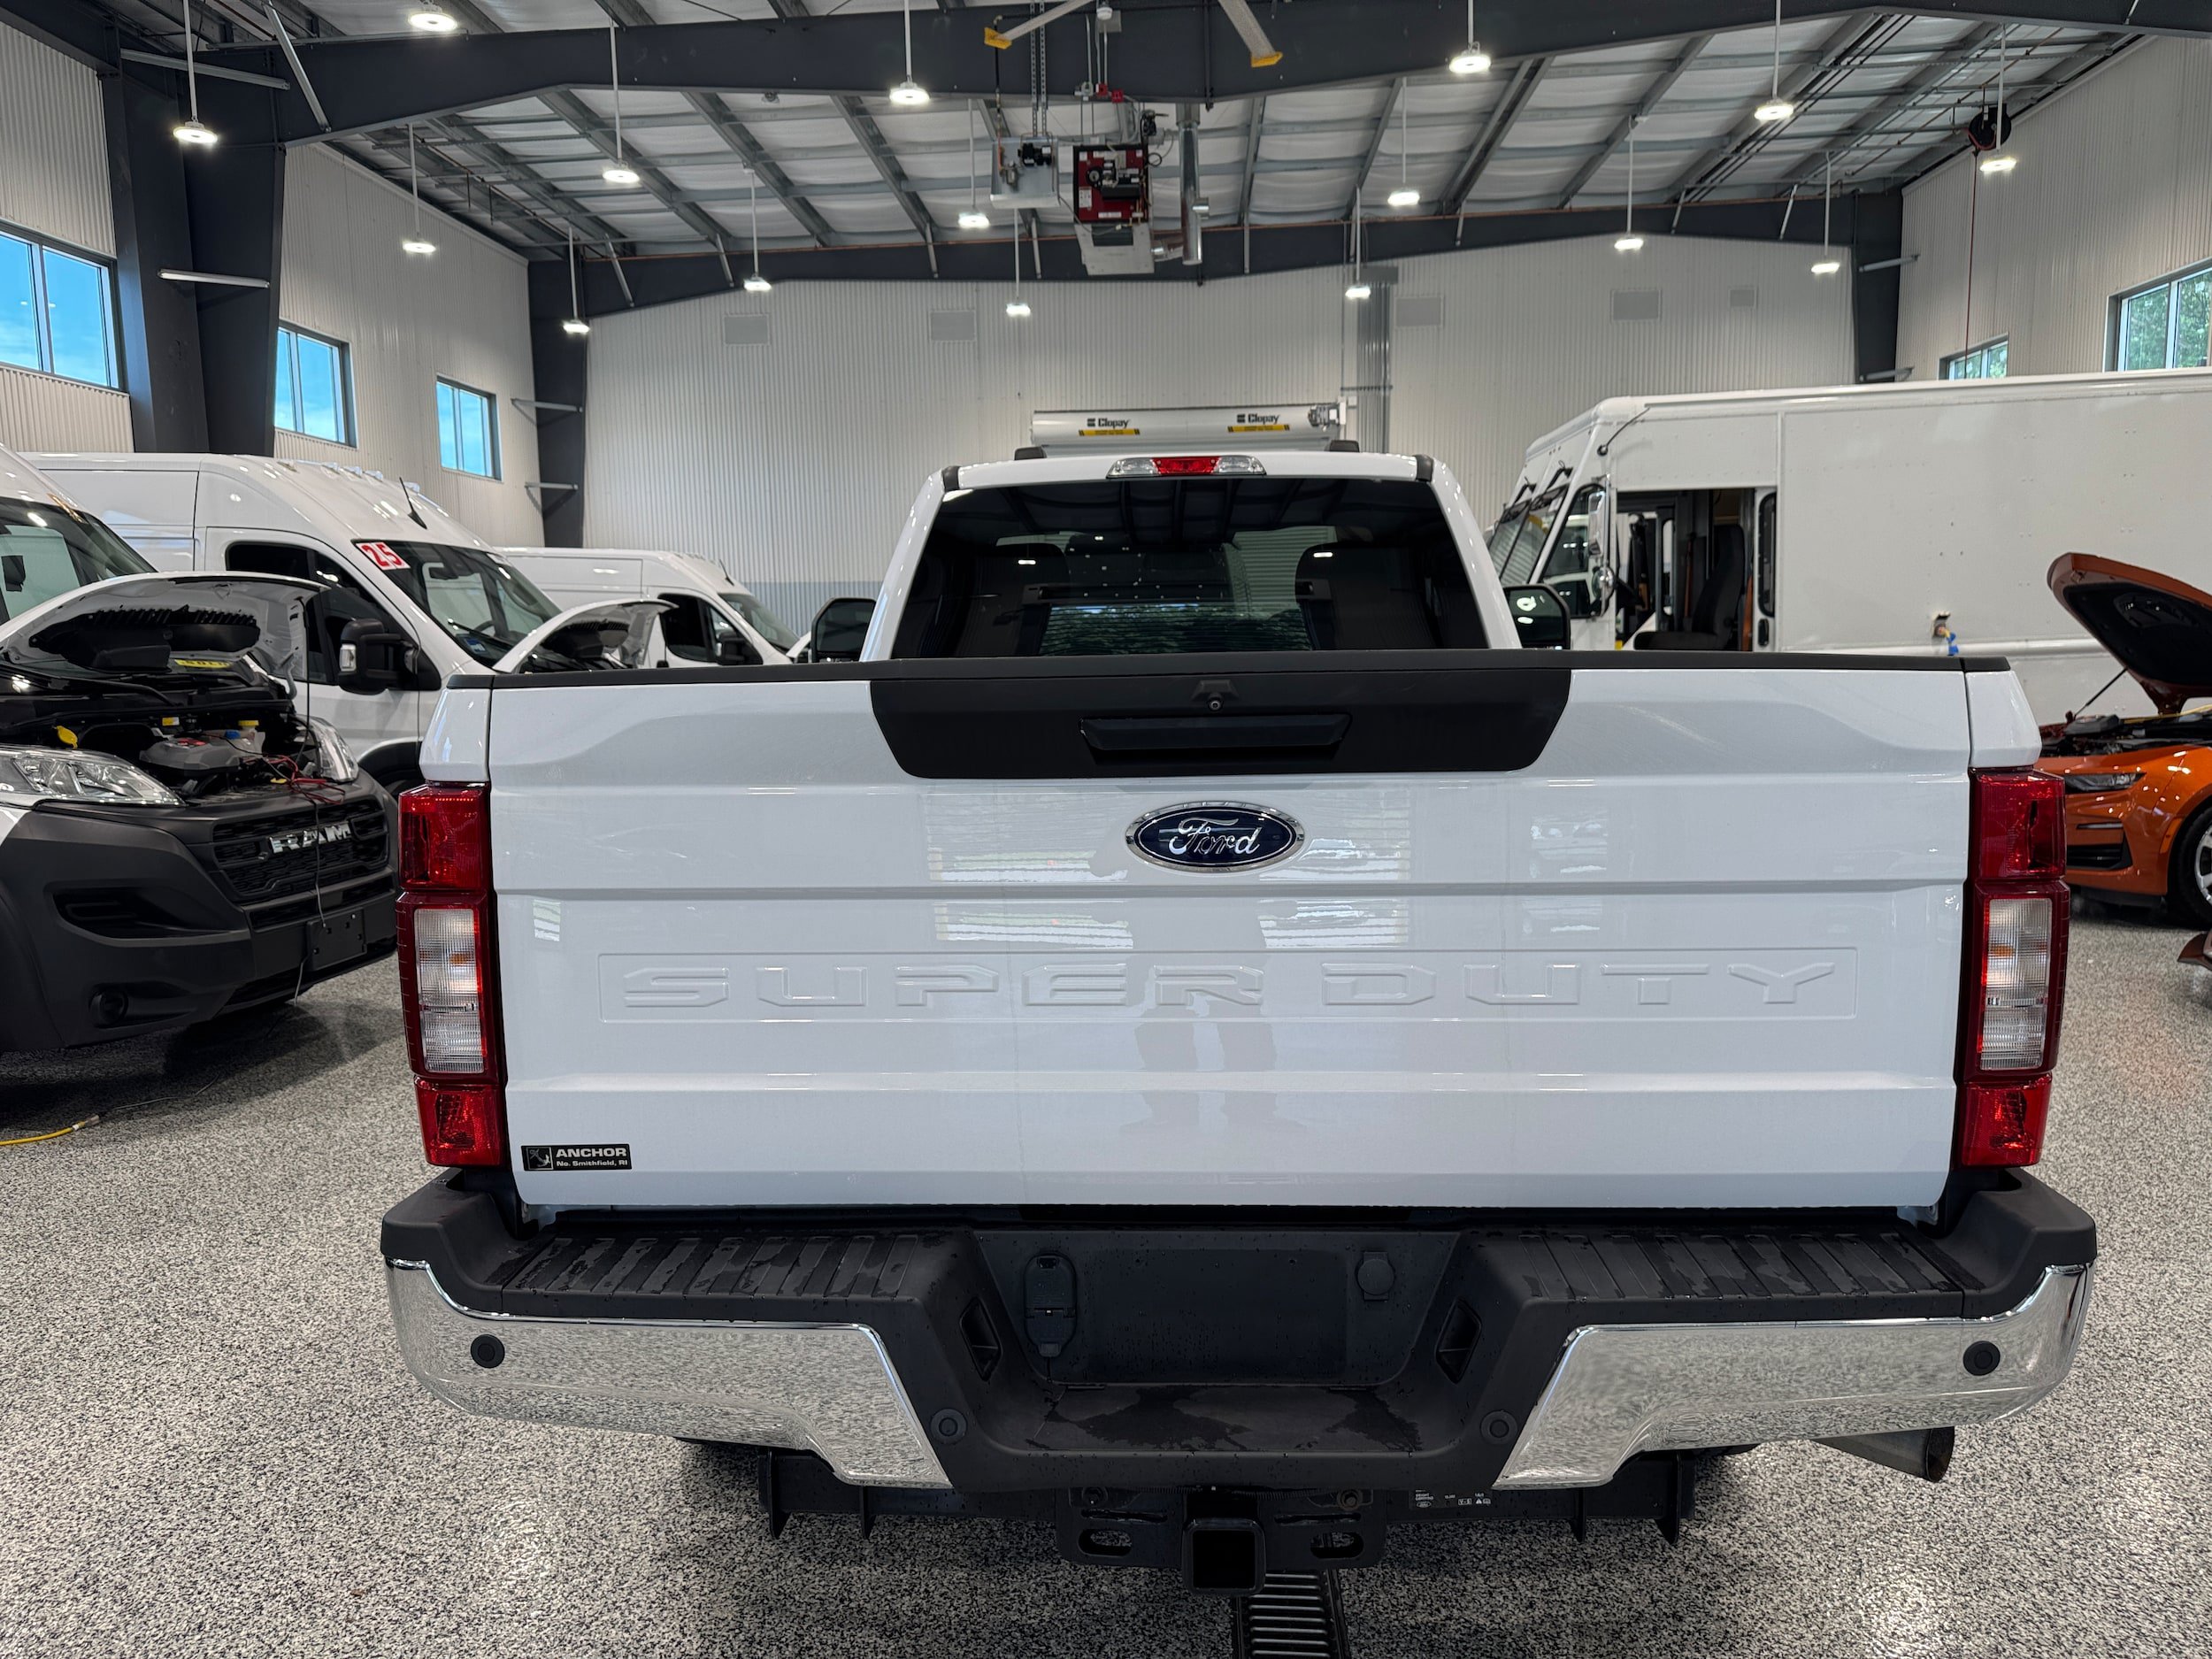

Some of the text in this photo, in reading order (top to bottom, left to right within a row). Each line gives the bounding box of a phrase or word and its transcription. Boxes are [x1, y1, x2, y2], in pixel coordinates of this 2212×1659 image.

[1098, 418, 1130, 429] Clopay
[1248, 413, 1280, 425] Clopay
[361, 544, 402, 566] 25
[270, 823, 351, 854] RAM
[1168, 817, 1263, 855] Ford
[624, 962, 1836, 1008] SUPER DUTY
[556, 1148, 627, 1157] ANCHOR
